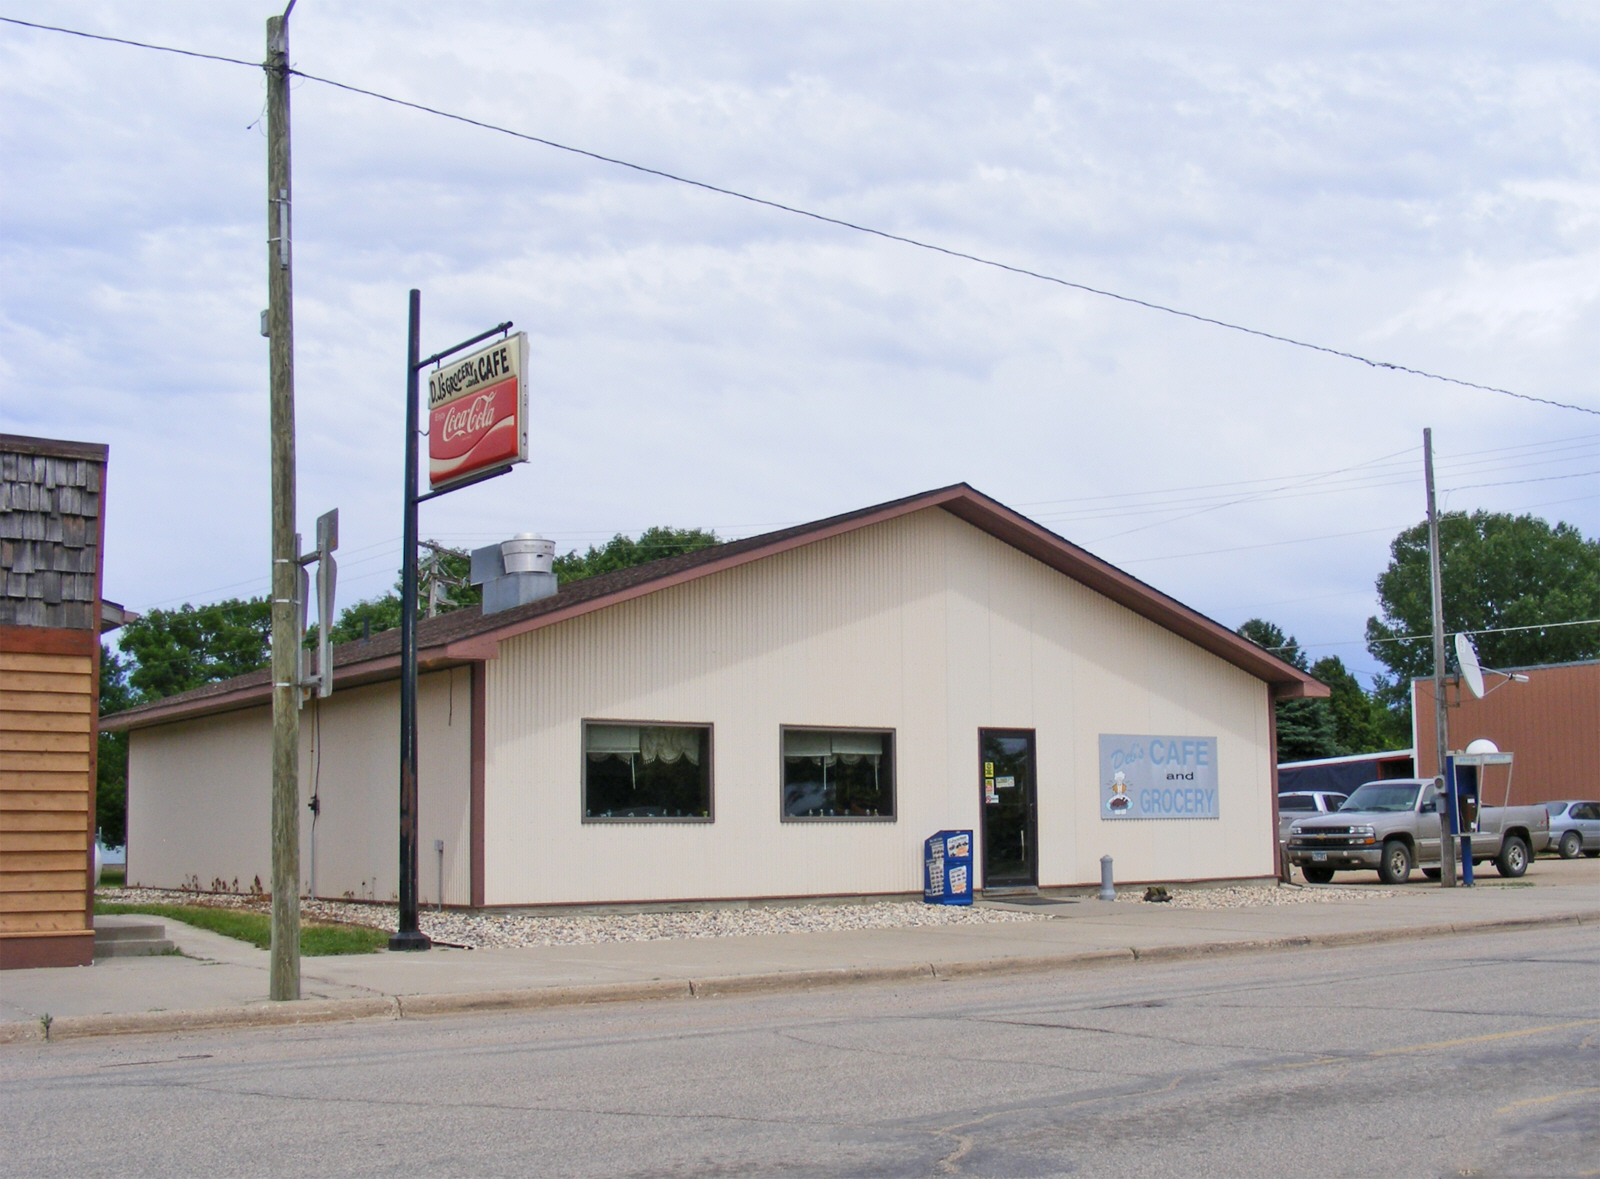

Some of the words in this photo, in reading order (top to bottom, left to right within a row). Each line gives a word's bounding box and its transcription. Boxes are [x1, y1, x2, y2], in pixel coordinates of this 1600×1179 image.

[446, 361, 475, 395] GROCERY
[478, 348, 510, 381] CAFE
[1149, 739, 1209, 766] CAFE
[1166, 772, 1194, 780] and
[1140, 788, 1214, 814] GROCERY
